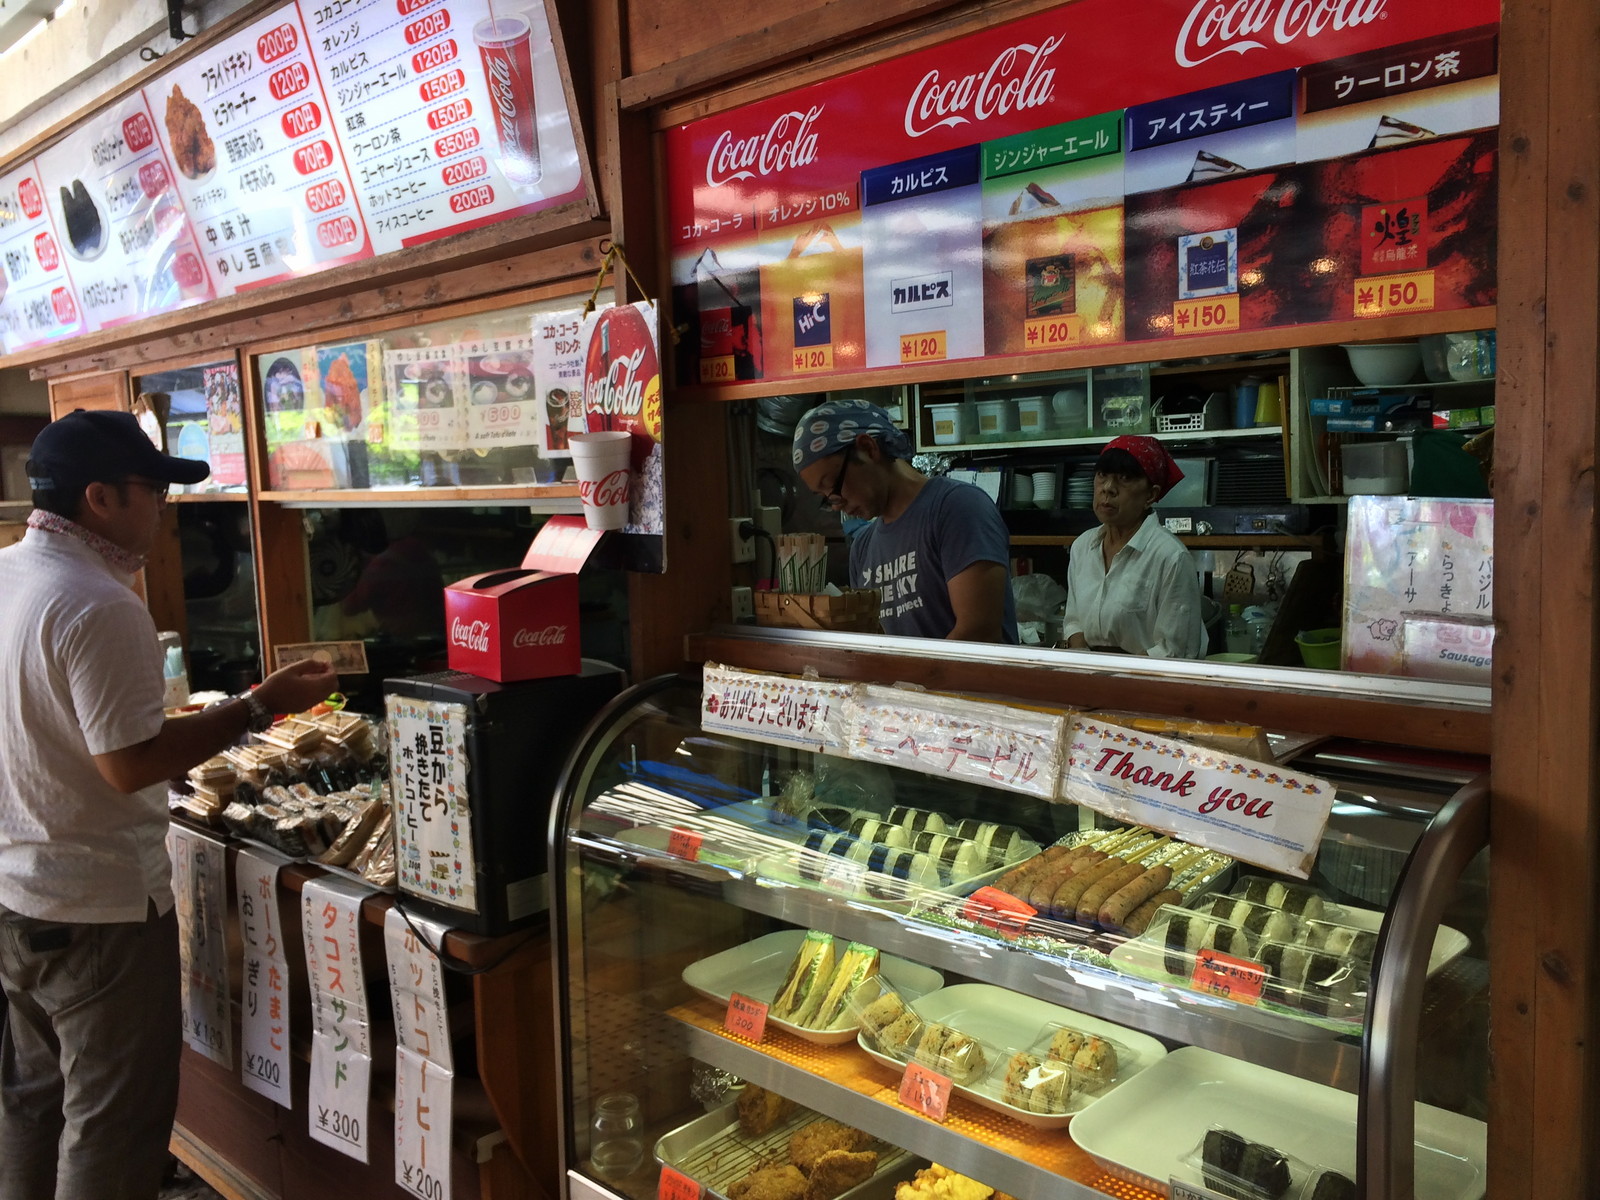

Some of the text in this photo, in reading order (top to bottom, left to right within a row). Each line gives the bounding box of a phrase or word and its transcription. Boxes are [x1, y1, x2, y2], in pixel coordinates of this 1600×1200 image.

[314, 0, 362, 25] コカコー
[408, 11, 445, 43] 120円
[322, 21, 360, 52] オレンジ
[201, 24, 296, 92] フライドチキン 200円
[337, 40, 454, 106] ジンジャーエール 120円
[1334, 50, 1461, 99] ウーロン茶
[212, 63, 307, 126] ヒラヤーチー 120円
[345, 71, 462, 132] 紅茶 150円
[287, 104, 317, 136] 70円
[353, 101, 470, 157] ウーロン茶 150円
[1147, 100, 1270, 140] アイスティー
[298, 142, 329, 173] 70円
[360, 128, 477, 183] ゴーヤージュース 350円
[993, 128, 1110, 171] ジンジャーエール
[368, 158, 484, 208] ホットコーヒー 200円
[891, 166, 949, 194] カルピス
[205, 212, 252, 247] 中味汁
[307, 180, 344, 211] 500円
[376, 187, 492, 234] アイスコーヒー 200円
[682, 213, 743, 240] コカ・コーラ
[1189, 259, 1226, 277] 紅茶花伝
[893, 281, 949, 305] カルピス
[1357, 281, 1418, 309] ¥150
[543, 322, 579, 340] コカ・コーラ
[1027, 322, 1068, 345] ¥120
[1177, 304, 1226, 329] ¥150
[794, 351, 825, 369] ¥120
[902, 337, 938, 357] ¥120
[875, 551, 916, 584] SHARE
[1404, 551, 1417, 604] アーサ
[1441, 554, 1455, 613] らっきょ
[1476, 556, 1493, 609] バジル
[1439, 649, 1492, 667] Sausage
[414, 732, 432, 822] 挽きたて
[429, 725, 449, 816] 豆から
[1094, 747, 1274, 819] Thank you
[402, 746, 418, 842] ホットコーヒー
[245, 1051, 280, 1083] ¥200
[404, 927, 431, 1169] ホットコーヒー
[318, 1104, 359, 1142] ¥300
[402, 1160, 443, 1200] ¥200
